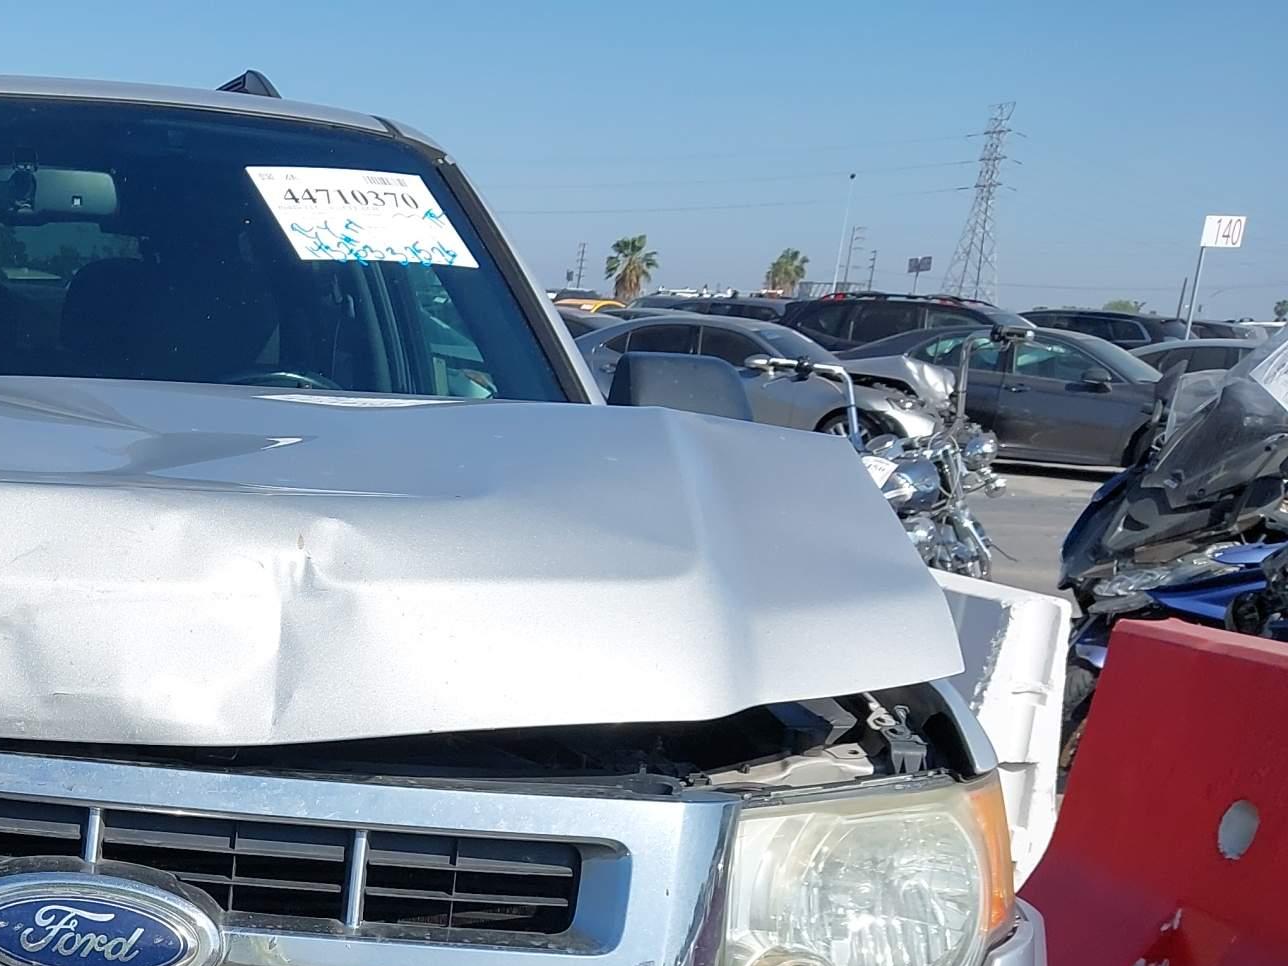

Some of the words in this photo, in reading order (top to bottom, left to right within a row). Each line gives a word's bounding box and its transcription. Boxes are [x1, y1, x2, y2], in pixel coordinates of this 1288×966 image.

[283, 188, 419, 209] 44710370
[1214, 218, 1242, 246] 140
[20, 905, 145, 962] Ford
